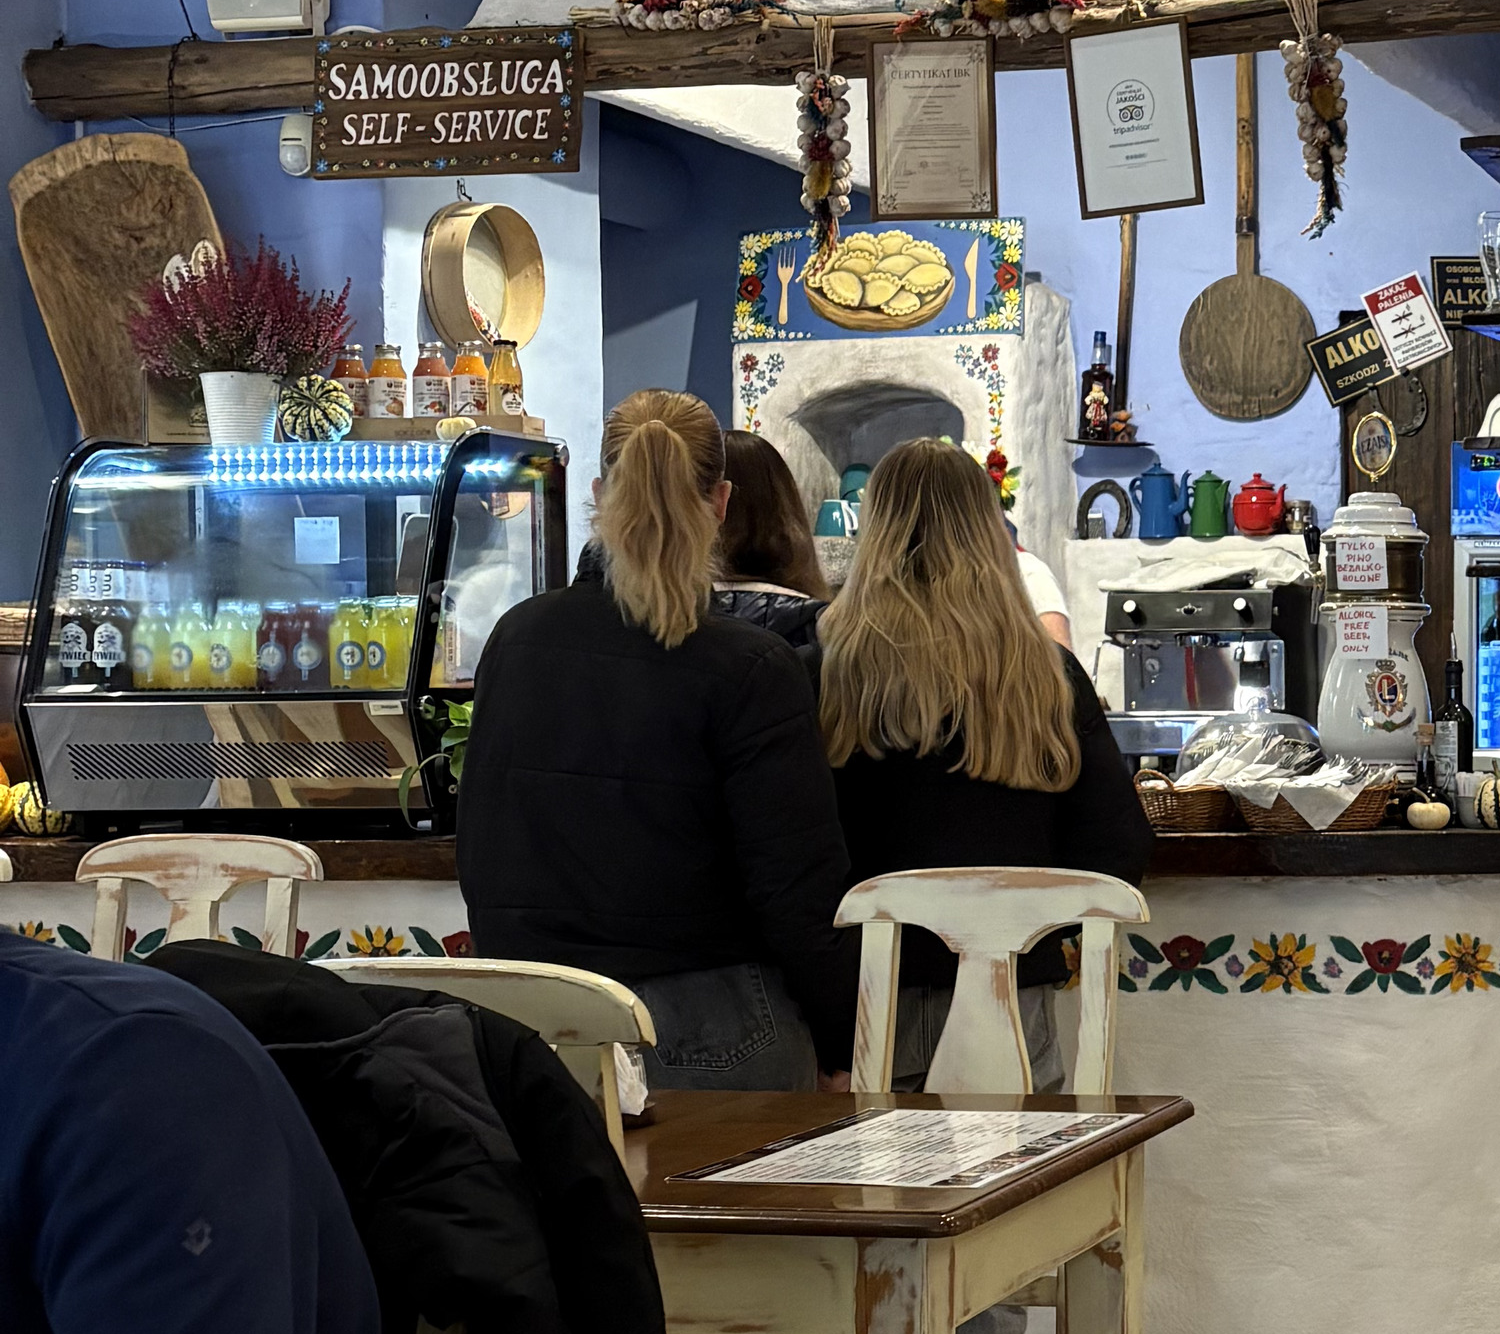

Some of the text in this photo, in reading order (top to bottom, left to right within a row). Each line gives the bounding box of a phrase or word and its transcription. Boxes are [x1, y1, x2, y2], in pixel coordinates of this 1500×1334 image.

[328, 58, 565, 101] SAMOOBSŁUGA
[1377, 281, 1408, 301] ZAKAZ
[1442, 287, 1489, 305] ALKO
[1377, 289, 1416, 312] PALENIA
[1336, 363, 1380, 388] SZKODZI
[1339, 542, 1375, 551] TYLKO
[1346, 553, 1372, 562] PIWO
[1344, 620, 1370, 630] FREE
[1342, 644, 1369, 653] ONLY
